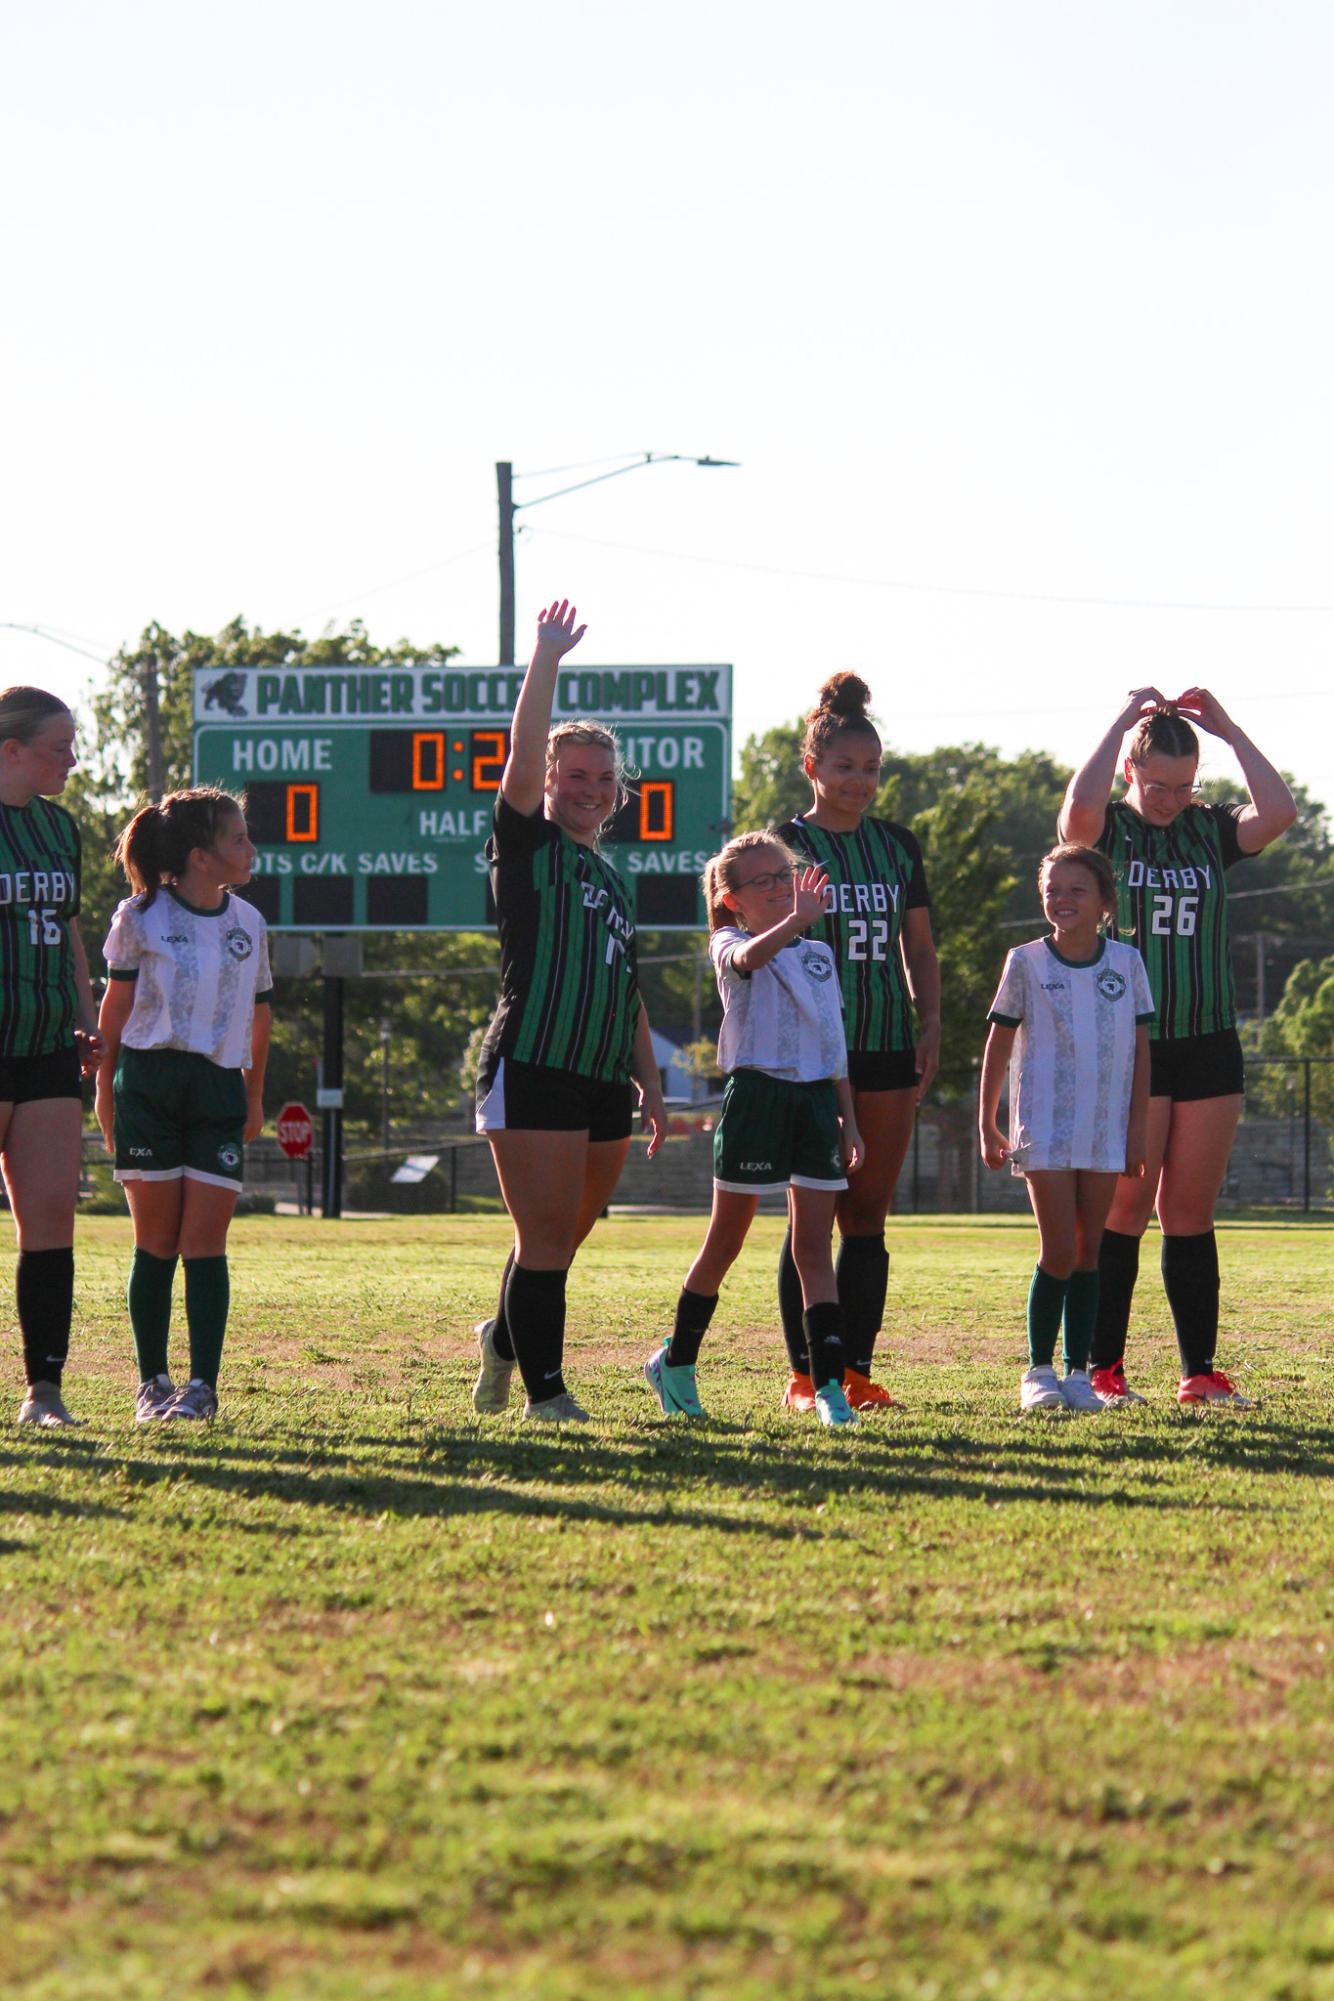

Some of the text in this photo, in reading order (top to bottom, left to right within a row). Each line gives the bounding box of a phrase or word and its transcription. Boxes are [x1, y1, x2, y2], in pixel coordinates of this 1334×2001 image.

[257, 671, 720, 714] PANTHER SOCCE COMPLEX
[233, 740, 333, 771] HOME
[286, 784, 317, 841] 0
[420, 810, 488, 836] HALF
[640, 782, 672, 840] 0
[301, 852, 346, 874] C/K
[358, 852, 438, 874] SAVES
[628, 851, 707, 873] SAVES
[1128, 861, 1211, 889] DERBY
[0, 871, 75, 904] DERBY
[823, 883, 900, 913] DERBY
[28, 909, 61, 945] 16
[1152, 895, 1199, 935] 26
[161, 935, 189, 944] LEXA
[848, 920, 888, 960] 22
[279, 1121, 311, 1143] STOP
[740, 1161, 773, 1171] LEXA
